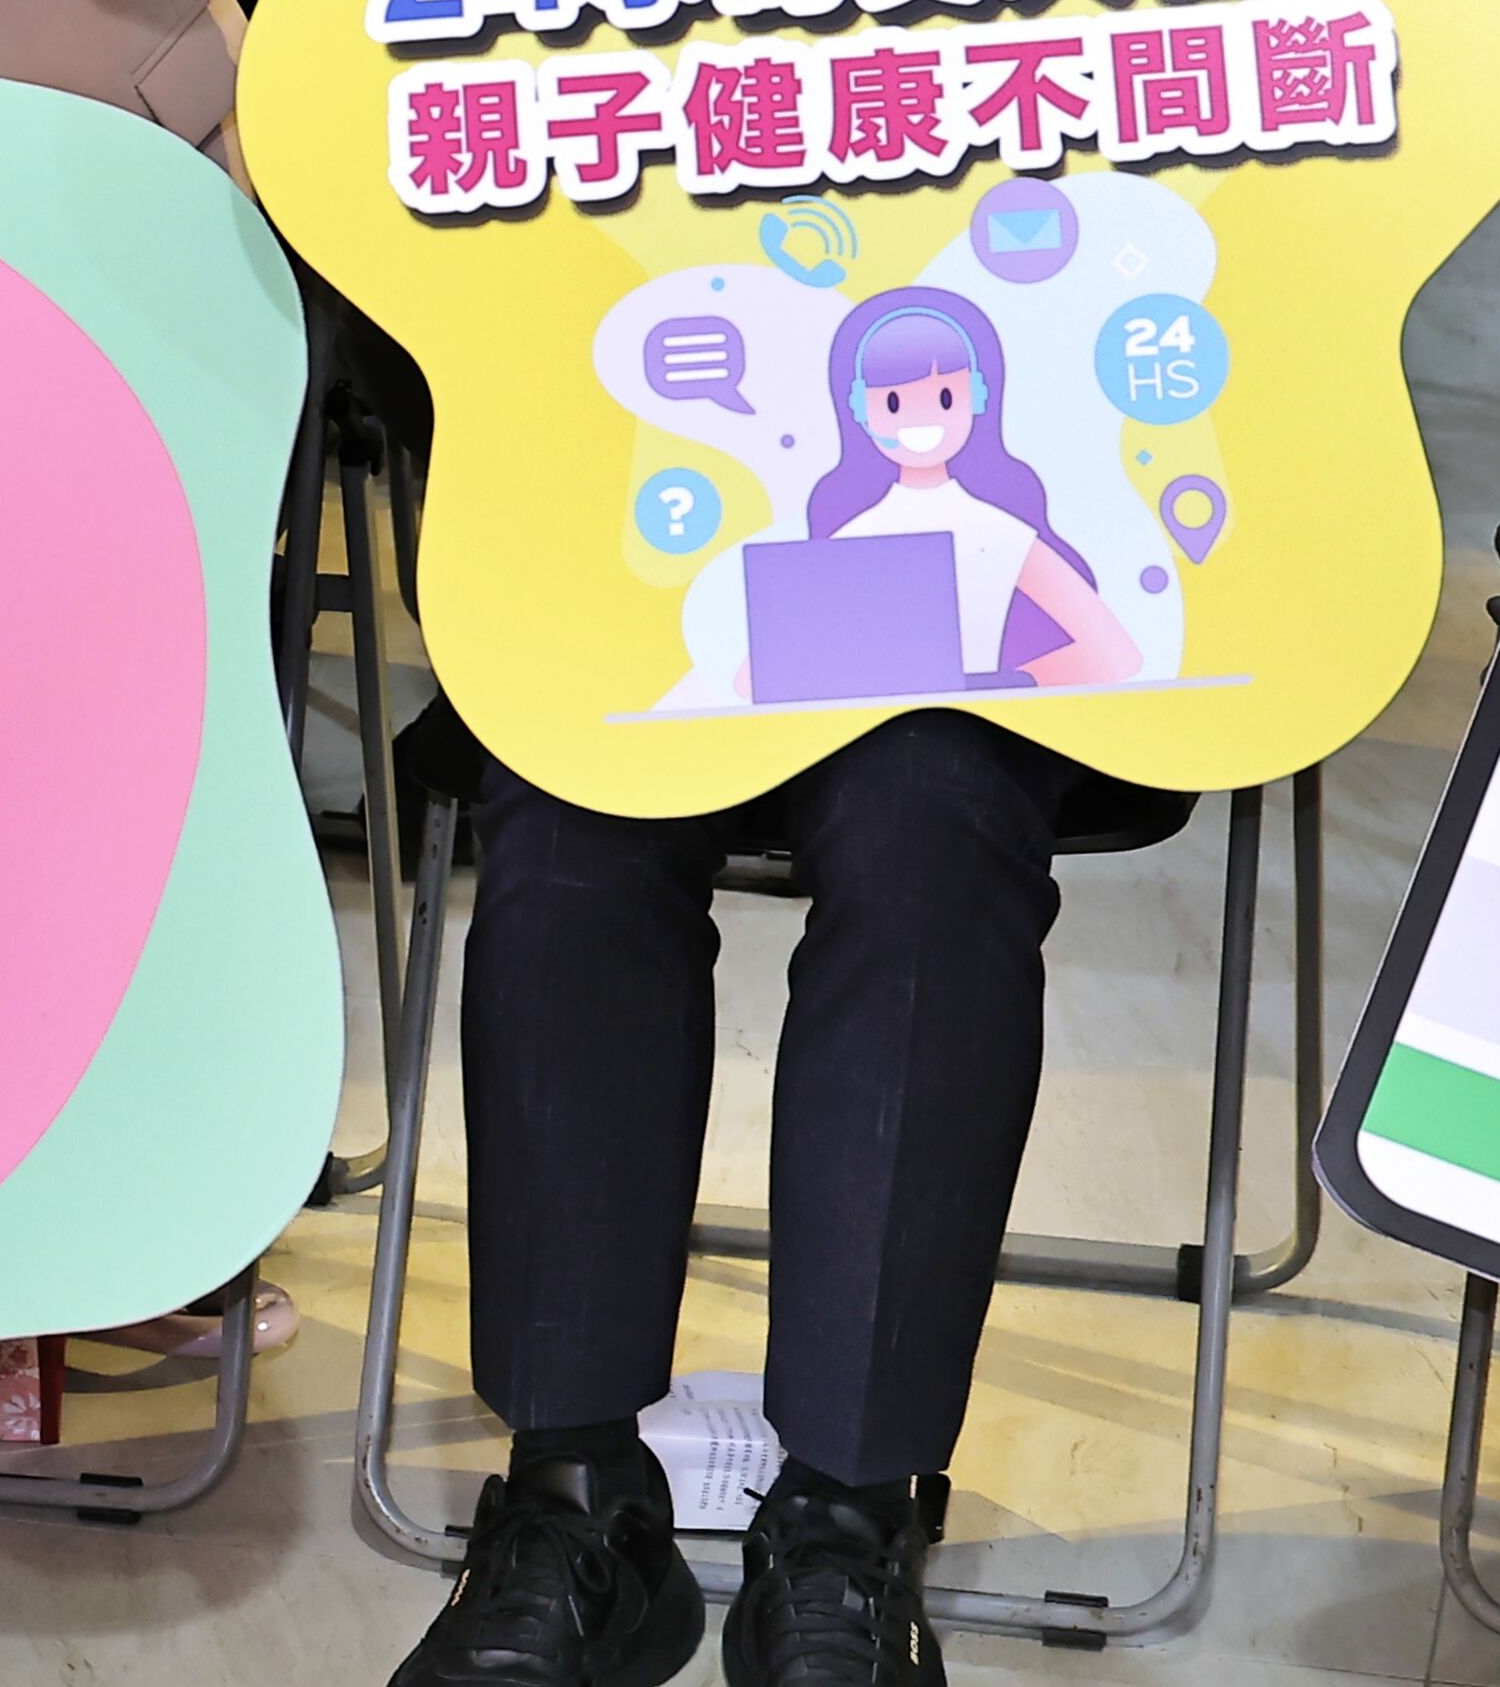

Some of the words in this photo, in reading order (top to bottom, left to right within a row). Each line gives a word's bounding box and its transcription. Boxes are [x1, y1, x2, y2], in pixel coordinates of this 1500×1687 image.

[407, 10, 1380, 198] 親子健康不間斷
[1124, 315, 1196, 358] 24
[1128, 360, 1200, 402] HS
